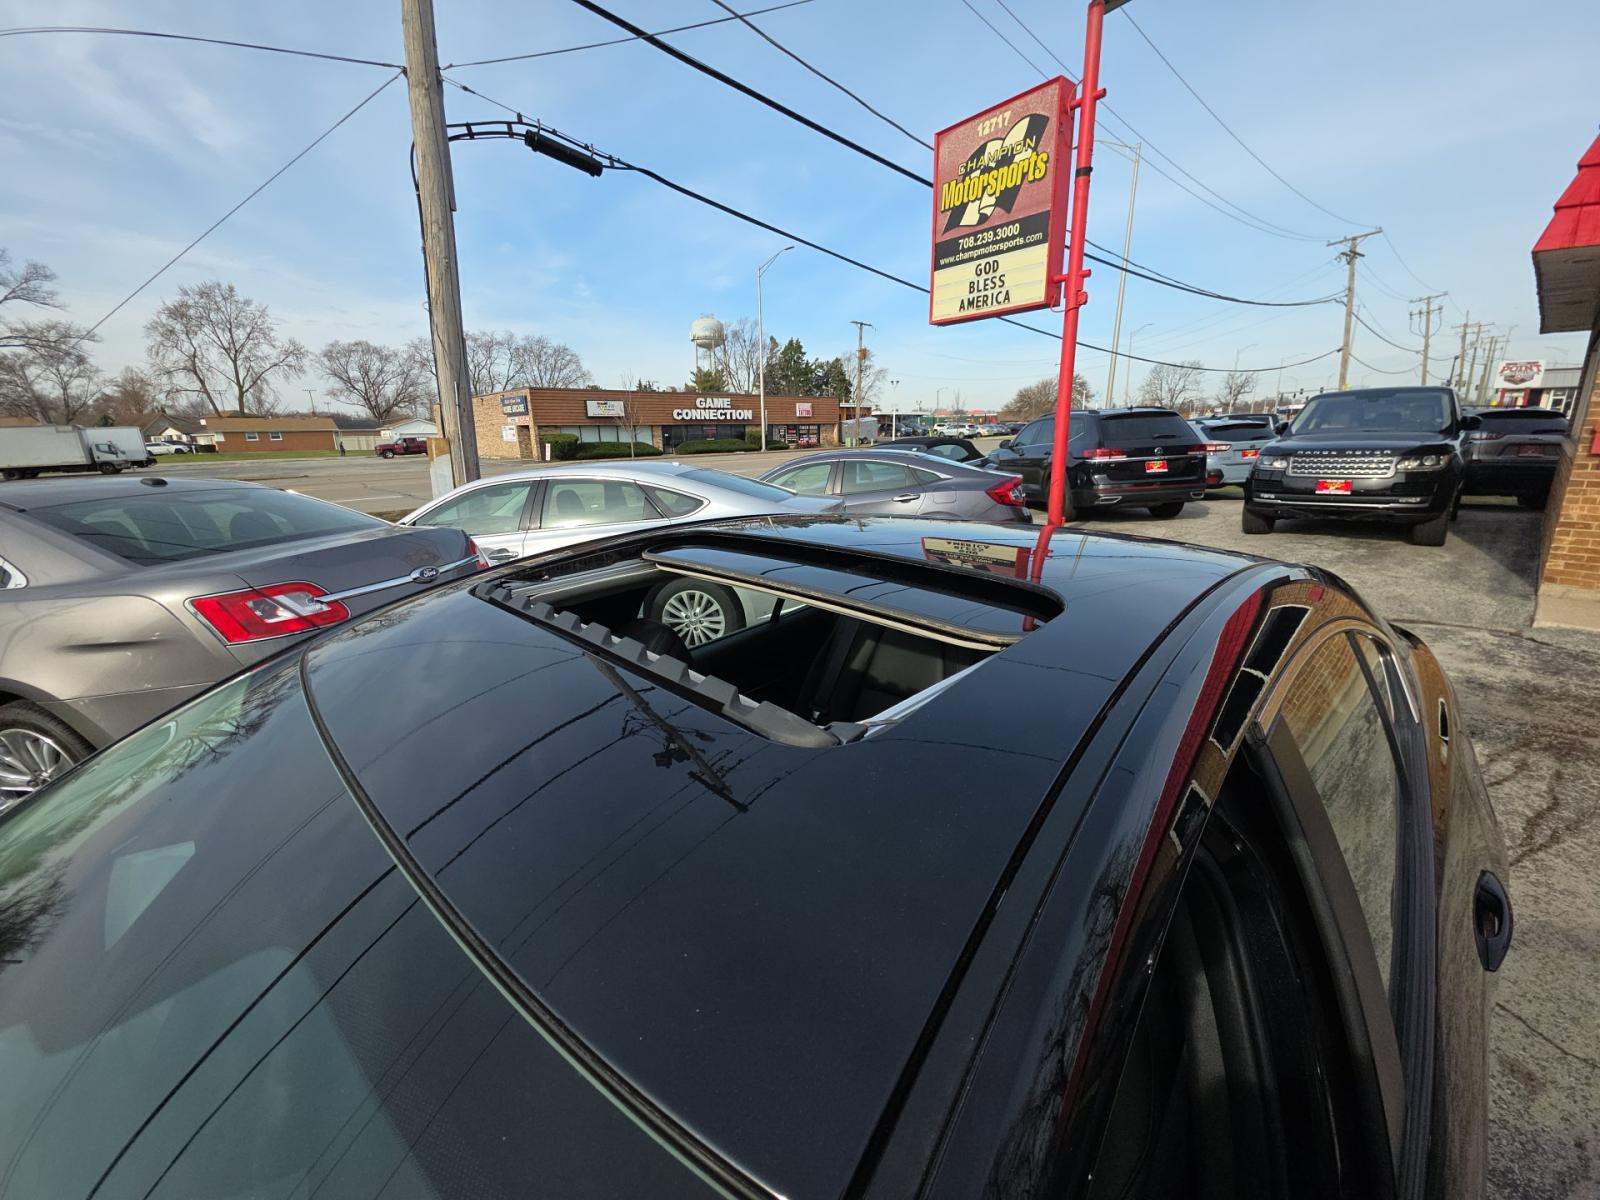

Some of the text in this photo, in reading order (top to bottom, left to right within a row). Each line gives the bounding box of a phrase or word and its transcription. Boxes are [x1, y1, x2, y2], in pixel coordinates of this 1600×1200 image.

[977, 110, 1011, 136] 12717
[958, 136, 1036, 175] CHAMPION
[941, 150, 1049, 212] Motorsports
[959, 223, 1020, 250] 708.239.3000
[940, 232, 1043, 266] www.champmotorsports.com
[975, 259, 1000, 276] GOD
[968, 275, 1005, 294] BLESS
[959, 290, 1010, 312] AMERICA
[696, 398, 731, 408] GAME
[672, 409, 752, 420] CONNECTION
[423, 567, 436, 577] Ford
